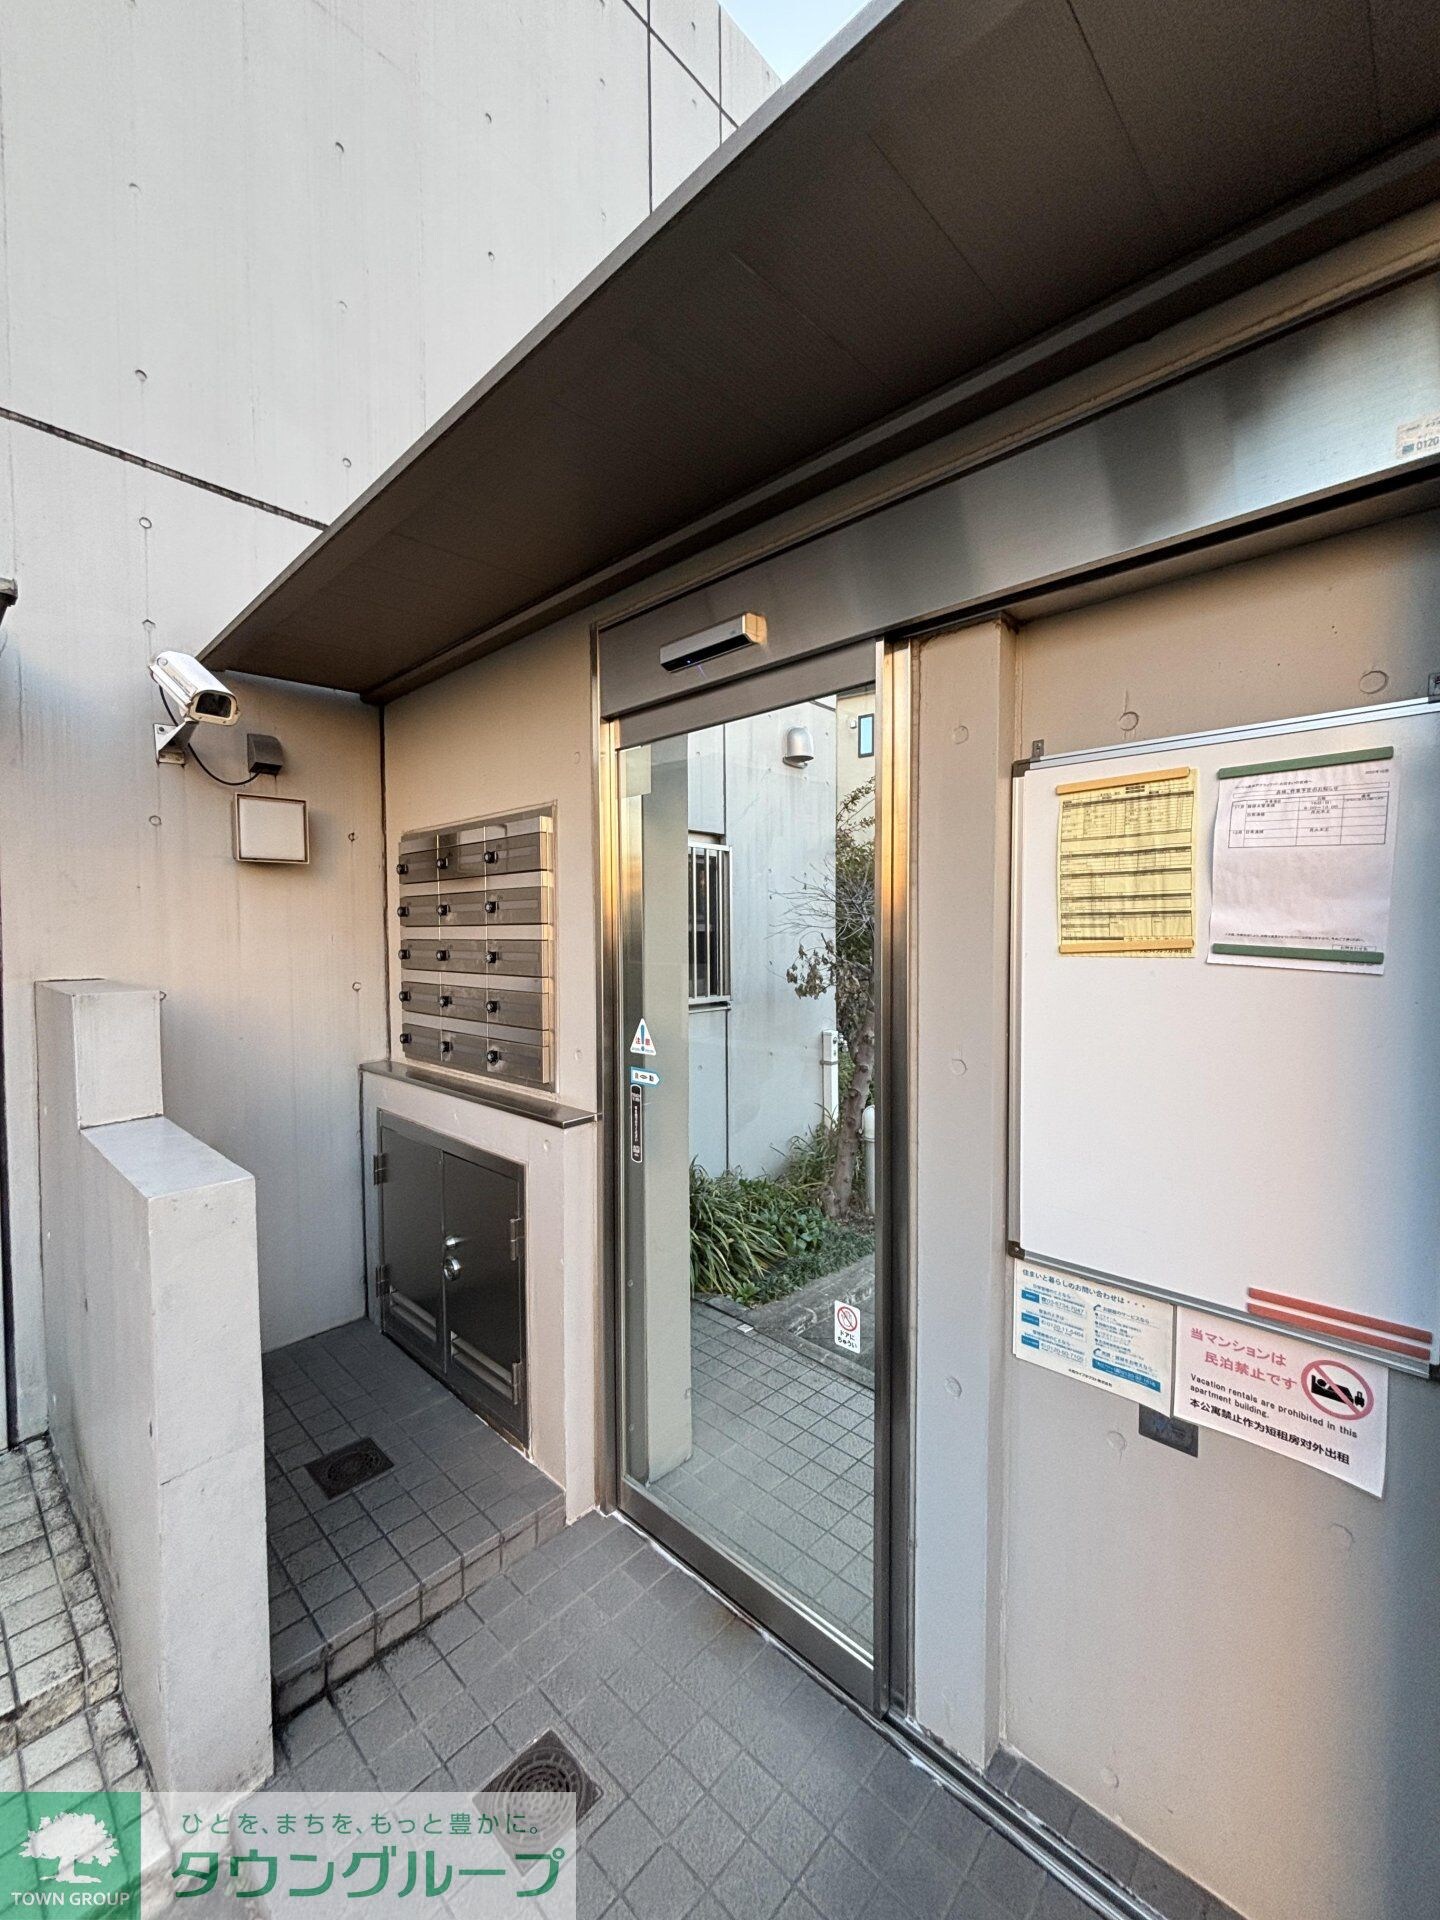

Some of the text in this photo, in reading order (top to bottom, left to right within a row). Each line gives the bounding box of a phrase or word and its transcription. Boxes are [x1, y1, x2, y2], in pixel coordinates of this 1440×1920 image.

[1416, 436, 1440, 450] 0120
[1190, 1327, 1287, 1367] 当マンションは
[1204, 1350, 1298, 1390] 民泊禁止です
[1190, 1384, 1270, 1419] apartment building.
[1190, 1373, 1358, 1439] Vacation rentals are prohibited in this
[1189, 1397, 1350, 1466] 本公寓禁止作为短租房对外出租
